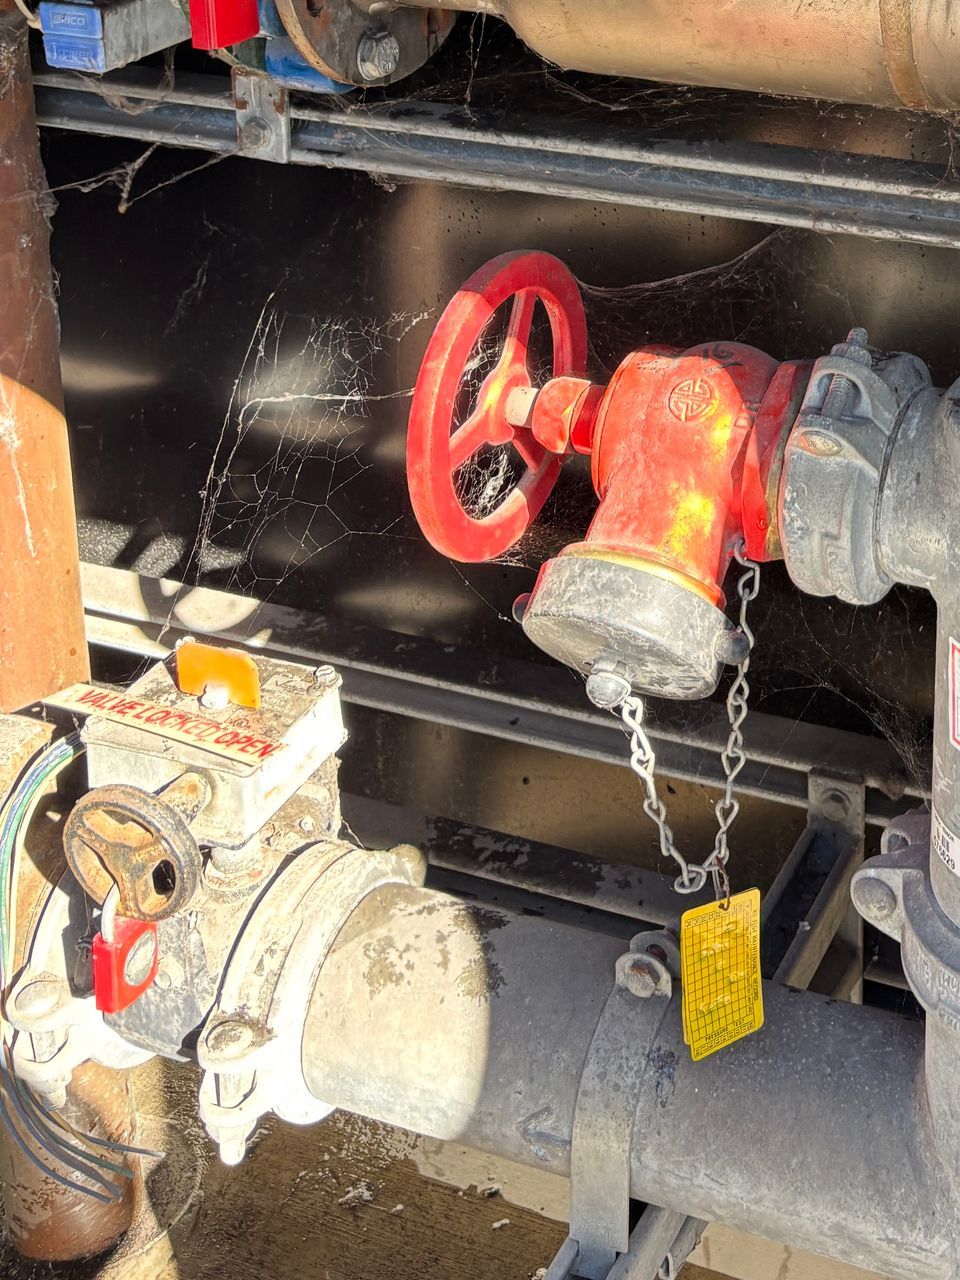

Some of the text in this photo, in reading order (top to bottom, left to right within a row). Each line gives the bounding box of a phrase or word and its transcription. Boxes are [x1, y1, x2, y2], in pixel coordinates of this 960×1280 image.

[76, 689, 281, 758] VALVE LOCKED OPEN
